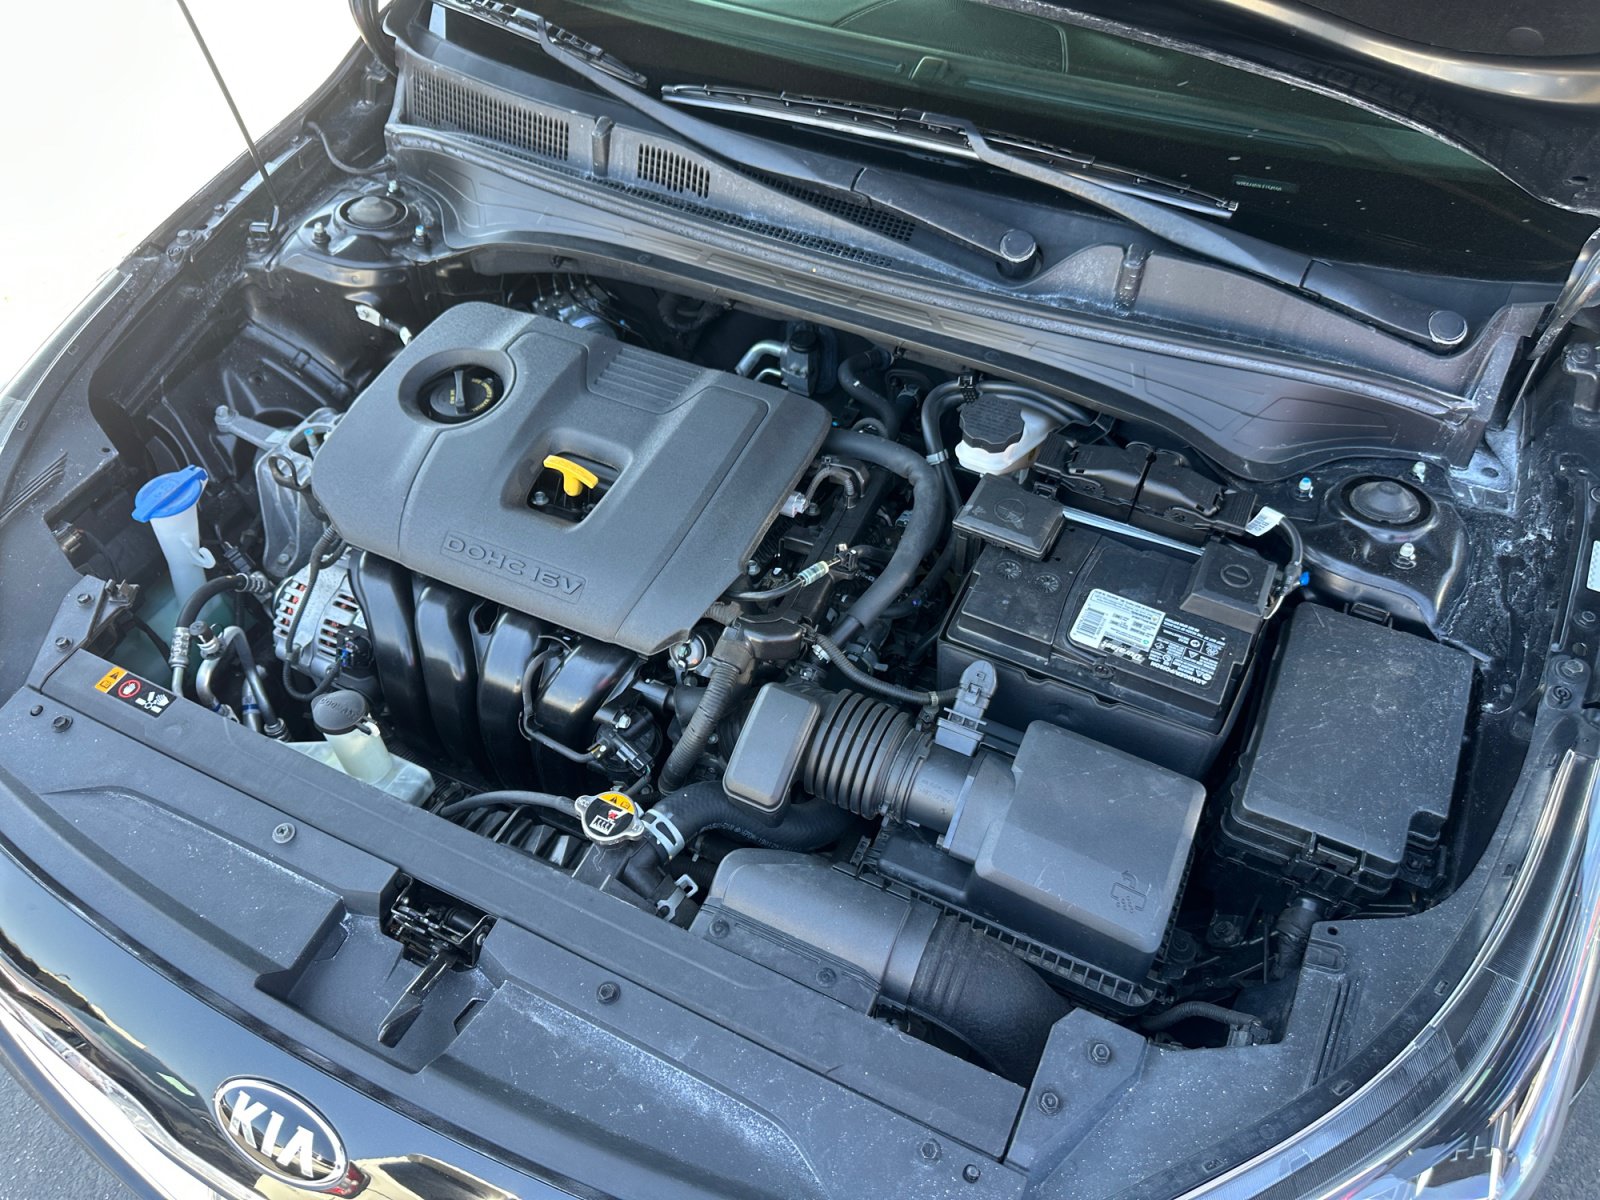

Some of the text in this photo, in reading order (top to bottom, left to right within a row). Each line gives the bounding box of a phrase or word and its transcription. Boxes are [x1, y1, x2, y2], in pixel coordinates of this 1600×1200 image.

[444, 535, 583, 596] DOHC 16V
[1100, 640, 1143, 662] Duralast
[228, 1090, 314, 1178] KIA
